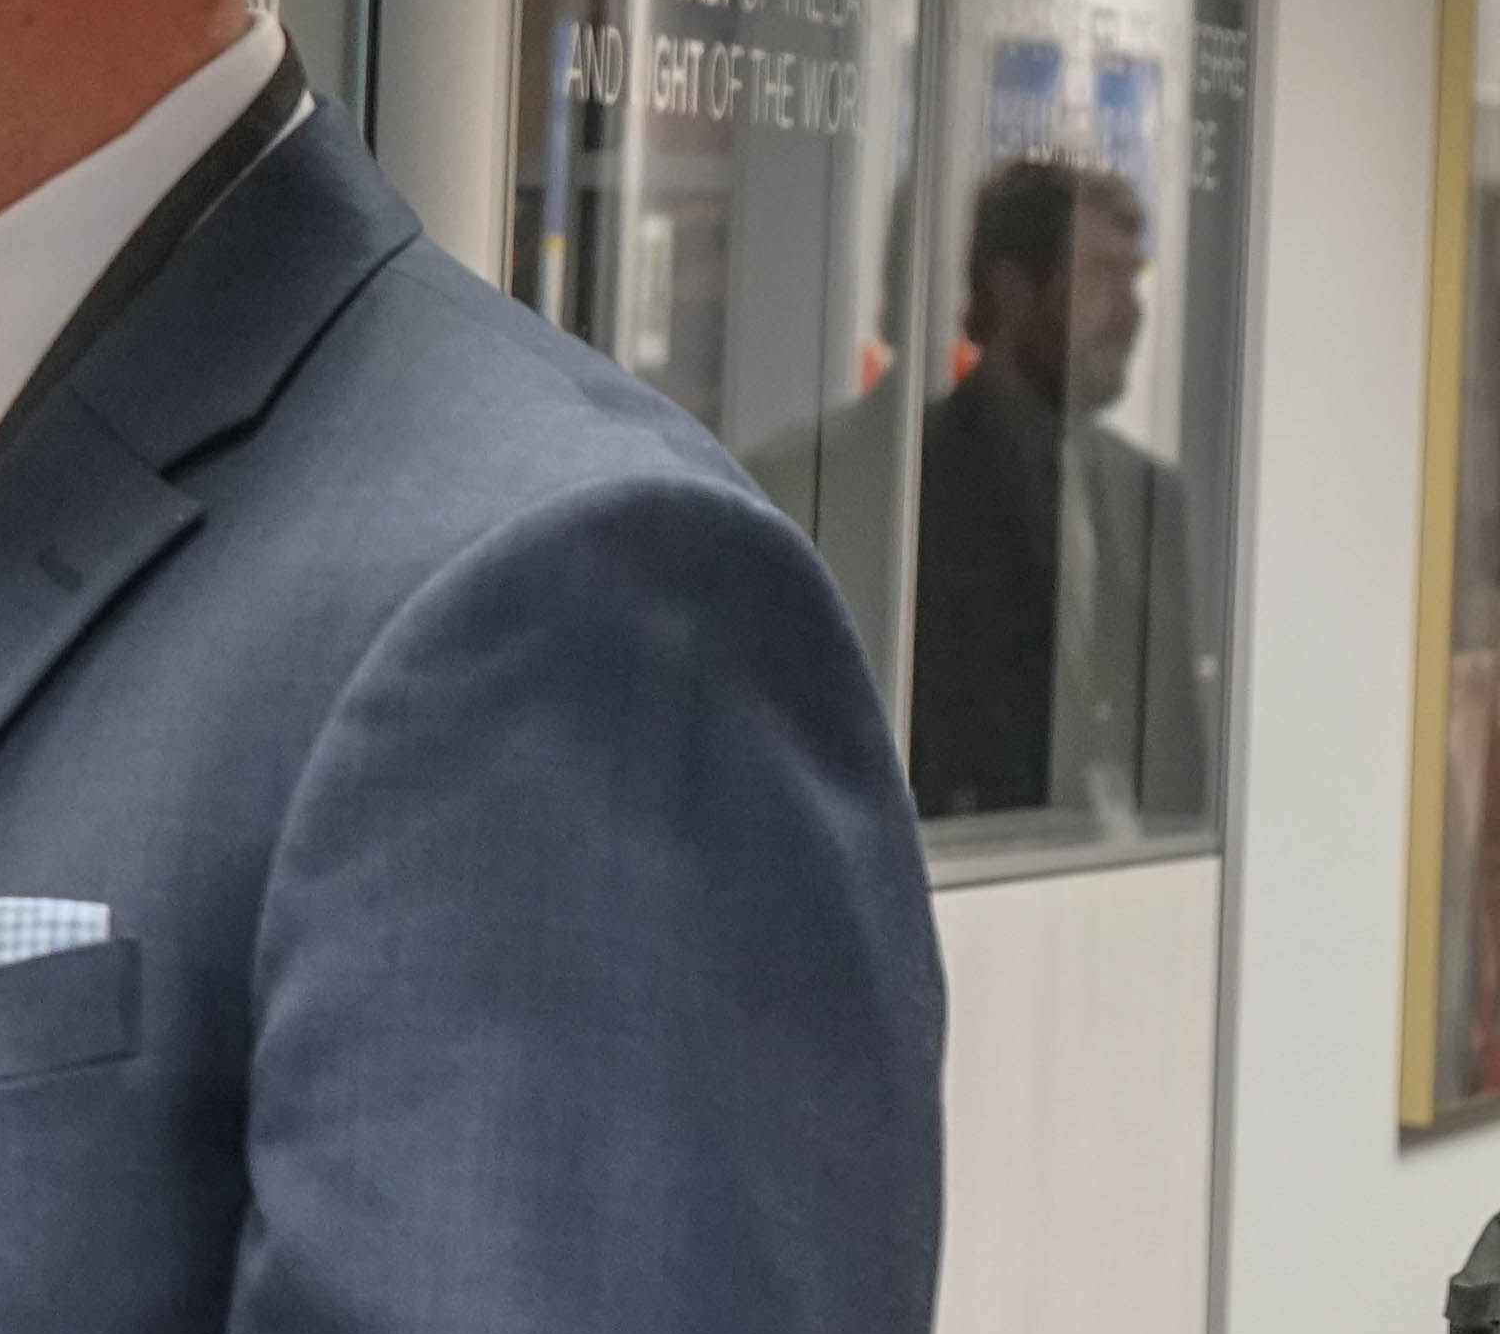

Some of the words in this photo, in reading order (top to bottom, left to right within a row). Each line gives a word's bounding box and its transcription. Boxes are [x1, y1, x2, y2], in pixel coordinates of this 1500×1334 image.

[562, 19, 624, 107] AND
[633, 34, 706, 117] IGHT
[709, 40, 747, 121] OF
[750, 48, 798, 129] THE
[801, 59, 862, 133] WOR
